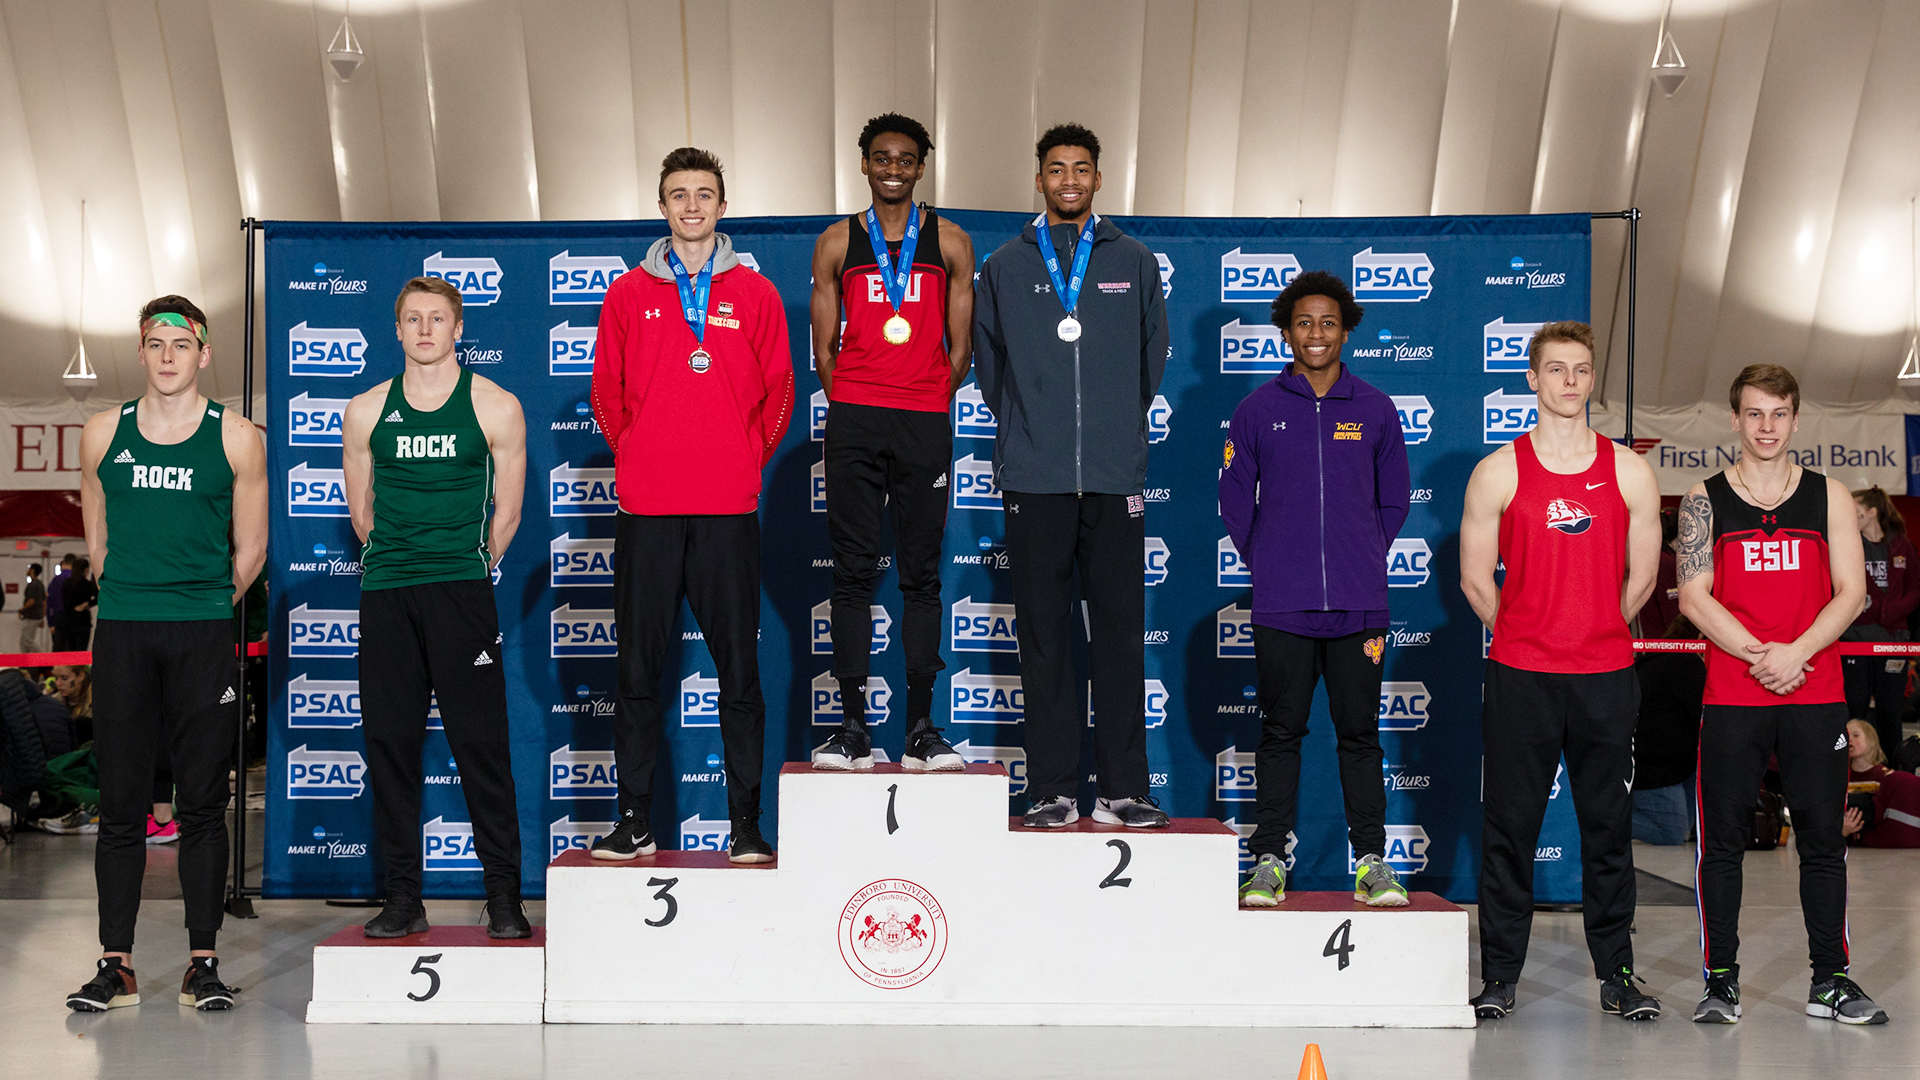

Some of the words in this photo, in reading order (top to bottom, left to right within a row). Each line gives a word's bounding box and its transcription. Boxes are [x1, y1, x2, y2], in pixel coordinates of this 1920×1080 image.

[289, 281, 316, 290] MAKE
[318, 280, 329, 290] IT
[329, 276, 368, 295] YOURS
[1223, 267, 1296, 288] PSAC
[1355, 266, 1429, 287] PSAC
[1485, 276, 1514, 285] MAKE
[1515, 275, 1526, 284] IT
[1526, 269, 1566, 290] YOURS
[865, 273, 923, 303] EU
[291, 341, 362, 362] PSAC
[463, 345, 503, 365] YOURS
[552, 340, 597, 361] PS
[1353, 348, 1382, 358] MAKE
[1383, 348, 1394, 357] IT
[1393, 342, 1434, 362] YOURS
[1486, 337, 1531, 358] PS
[291, 411, 344, 431] PSA
[958, 402, 998, 424] PS
[1486, 408, 1538, 429] PSA
[551, 422, 579, 430] MAKE
[580, 421, 590, 430] IT
[1335, 422, 1364, 430] WCU
[395, 435, 457, 458] ROCK
[1659, 445, 1708, 468] First
[1716, 445, 1822, 468] Nanal
[1831, 445, 1897, 468] Bank
[131, 465, 194, 491] ROCK
[957, 473, 1000, 495] PS
[291, 481, 345, 502] PSA
[1142, 488, 1171, 502] URS
[1409, 489, 1433, 503] URS
[811, 559, 835, 568] MAK
[952, 555, 982, 564] MAKE
[982, 556, 993, 564] IT
[1387, 552, 1427, 572] AC
[1741, 540, 1801, 571] ESU
[289, 563, 317, 572] MAKE
[318, 563, 328, 571] IT
[291, 622, 360, 643] PSAC
[681, 631, 705, 640] MAK
[813, 619, 886, 640] PC
[1144, 630, 1169, 645] URS
[1219, 622, 1255, 643] PS
[1391, 627, 1432, 648] YOURS
[1645, 642, 1684, 650] UNIVERSITY
[1684, 642, 1707, 650] FIGHTI
[1873, 644, 1908, 653] EDINBORO
[473, 658, 494, 667] adidas
[291, 693, 362, 714] PSAC
[551, 704, 579, 713] MAKE
[581, 704, 590, 713] IT
[591, 697, 616, 717] YOU
[683, 692, 720, 712] PS
[814, 690, 887, 711] PSC
[953, 688, 1025, 709] PSAC
[1217, 705, 1246, 714] MAKE
[1247, 705, 1258, 714] IT
[290, 763, 361, 784] PSAC
[424, 776, 451, 785] MAKE
[681, 774, 709, 783] MAKE
[711, 773, 721, 782] IT
[1218, 765, 1257, 786] PS
[1390, 771, 1431, 791] YOURS
[886, 783, 899, 835] 1
[288, 846, 315, 855] MAKE
[317, 845, 327, 854] IT
[327, 839, 367, 859] YOURS
[425, 835, 476, 856] PSA
[1384, 838, 1425, 859] AC
[1535, 846, 1562, 861] URS
[1098, 838, 1132, 889] 2
[644, 876, 679, 928] 3
[844, 882, 887, 921] EDINBORO
[893, 882, 943, 920] UNIVERSITY
[877, 894, 909, 902] FOUNDED
[1322, 918, 1355, 971] 4
[407, 953, 443, 1001] 5
[874, 971, 924, 986] PENNSYLVANIA
